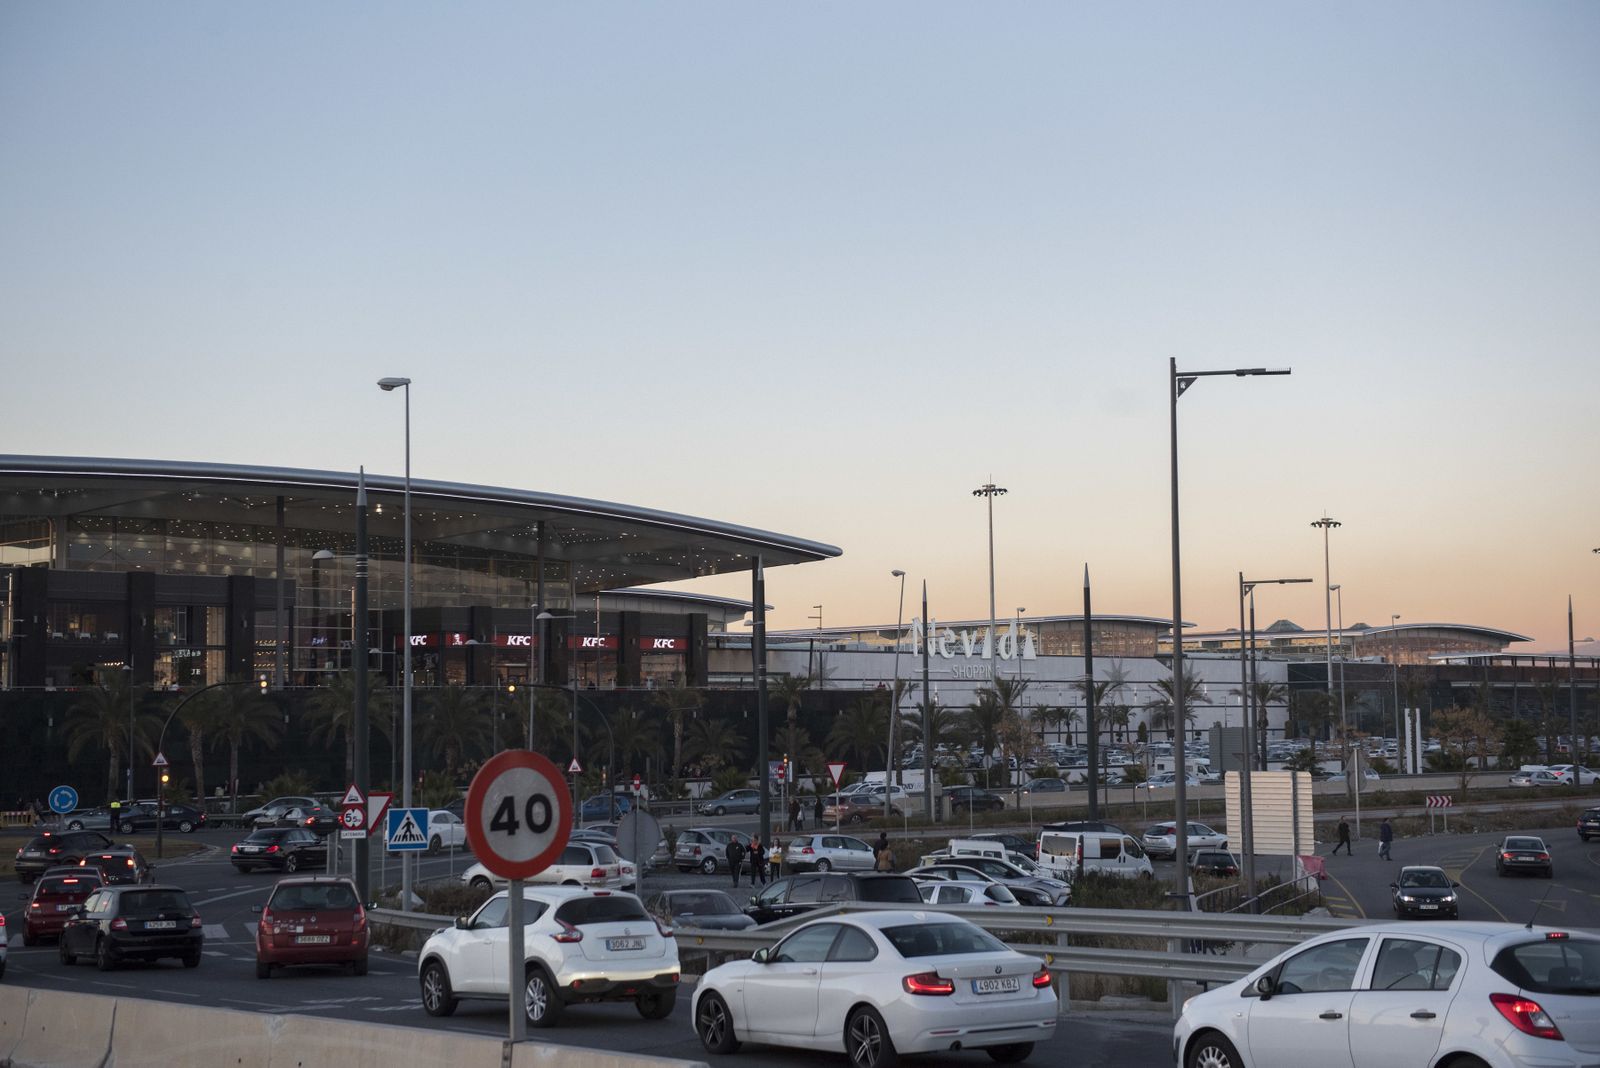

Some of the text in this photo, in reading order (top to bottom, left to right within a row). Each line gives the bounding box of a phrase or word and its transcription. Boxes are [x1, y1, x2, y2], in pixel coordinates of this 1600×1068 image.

[409, 635, 427, 645] KFC
[507, 635, 531, 646] KFC
[582, 637, 605, 647] KFC
[653, 638, 675, 648] KFC
[490, 793, 552, 836] 40
[979, 978, 1017, 990] 4902 KBZ
